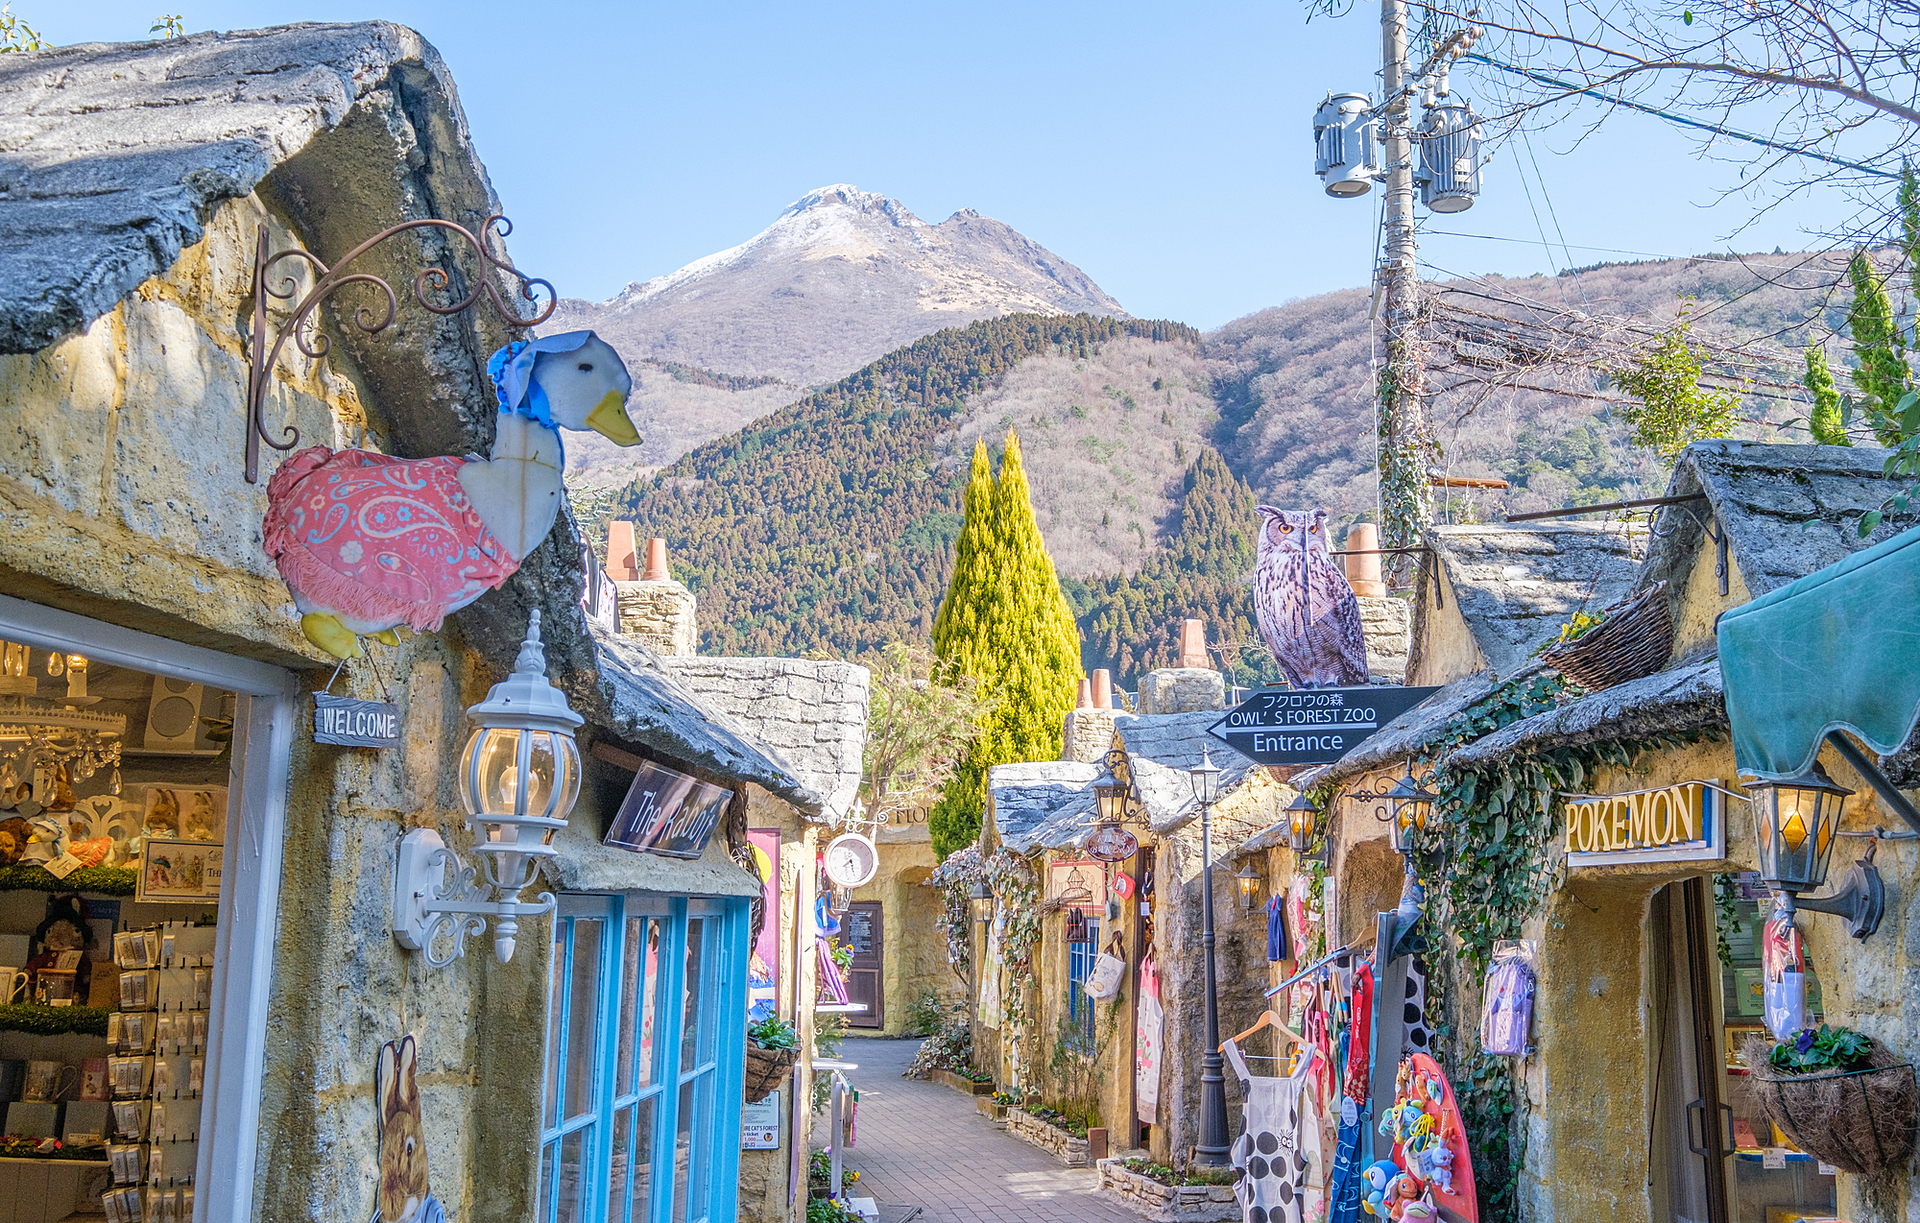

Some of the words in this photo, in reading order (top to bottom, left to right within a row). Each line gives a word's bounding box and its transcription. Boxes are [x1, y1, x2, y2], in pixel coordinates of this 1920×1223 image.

[1263, 693, 1344, 708] フクロウの森
[323, 708, 396, 738] WELCOME
[1287, 709, 1340, 724] FOREST
[1343, 708, 1376, 722] ZOO
[1254, 733, 1343, 752] Entrance
[629, 790, 662, 835] The
[658, 797, 716, 850] Rabbit
[1563, 784, 1695, 853] POKEMON
